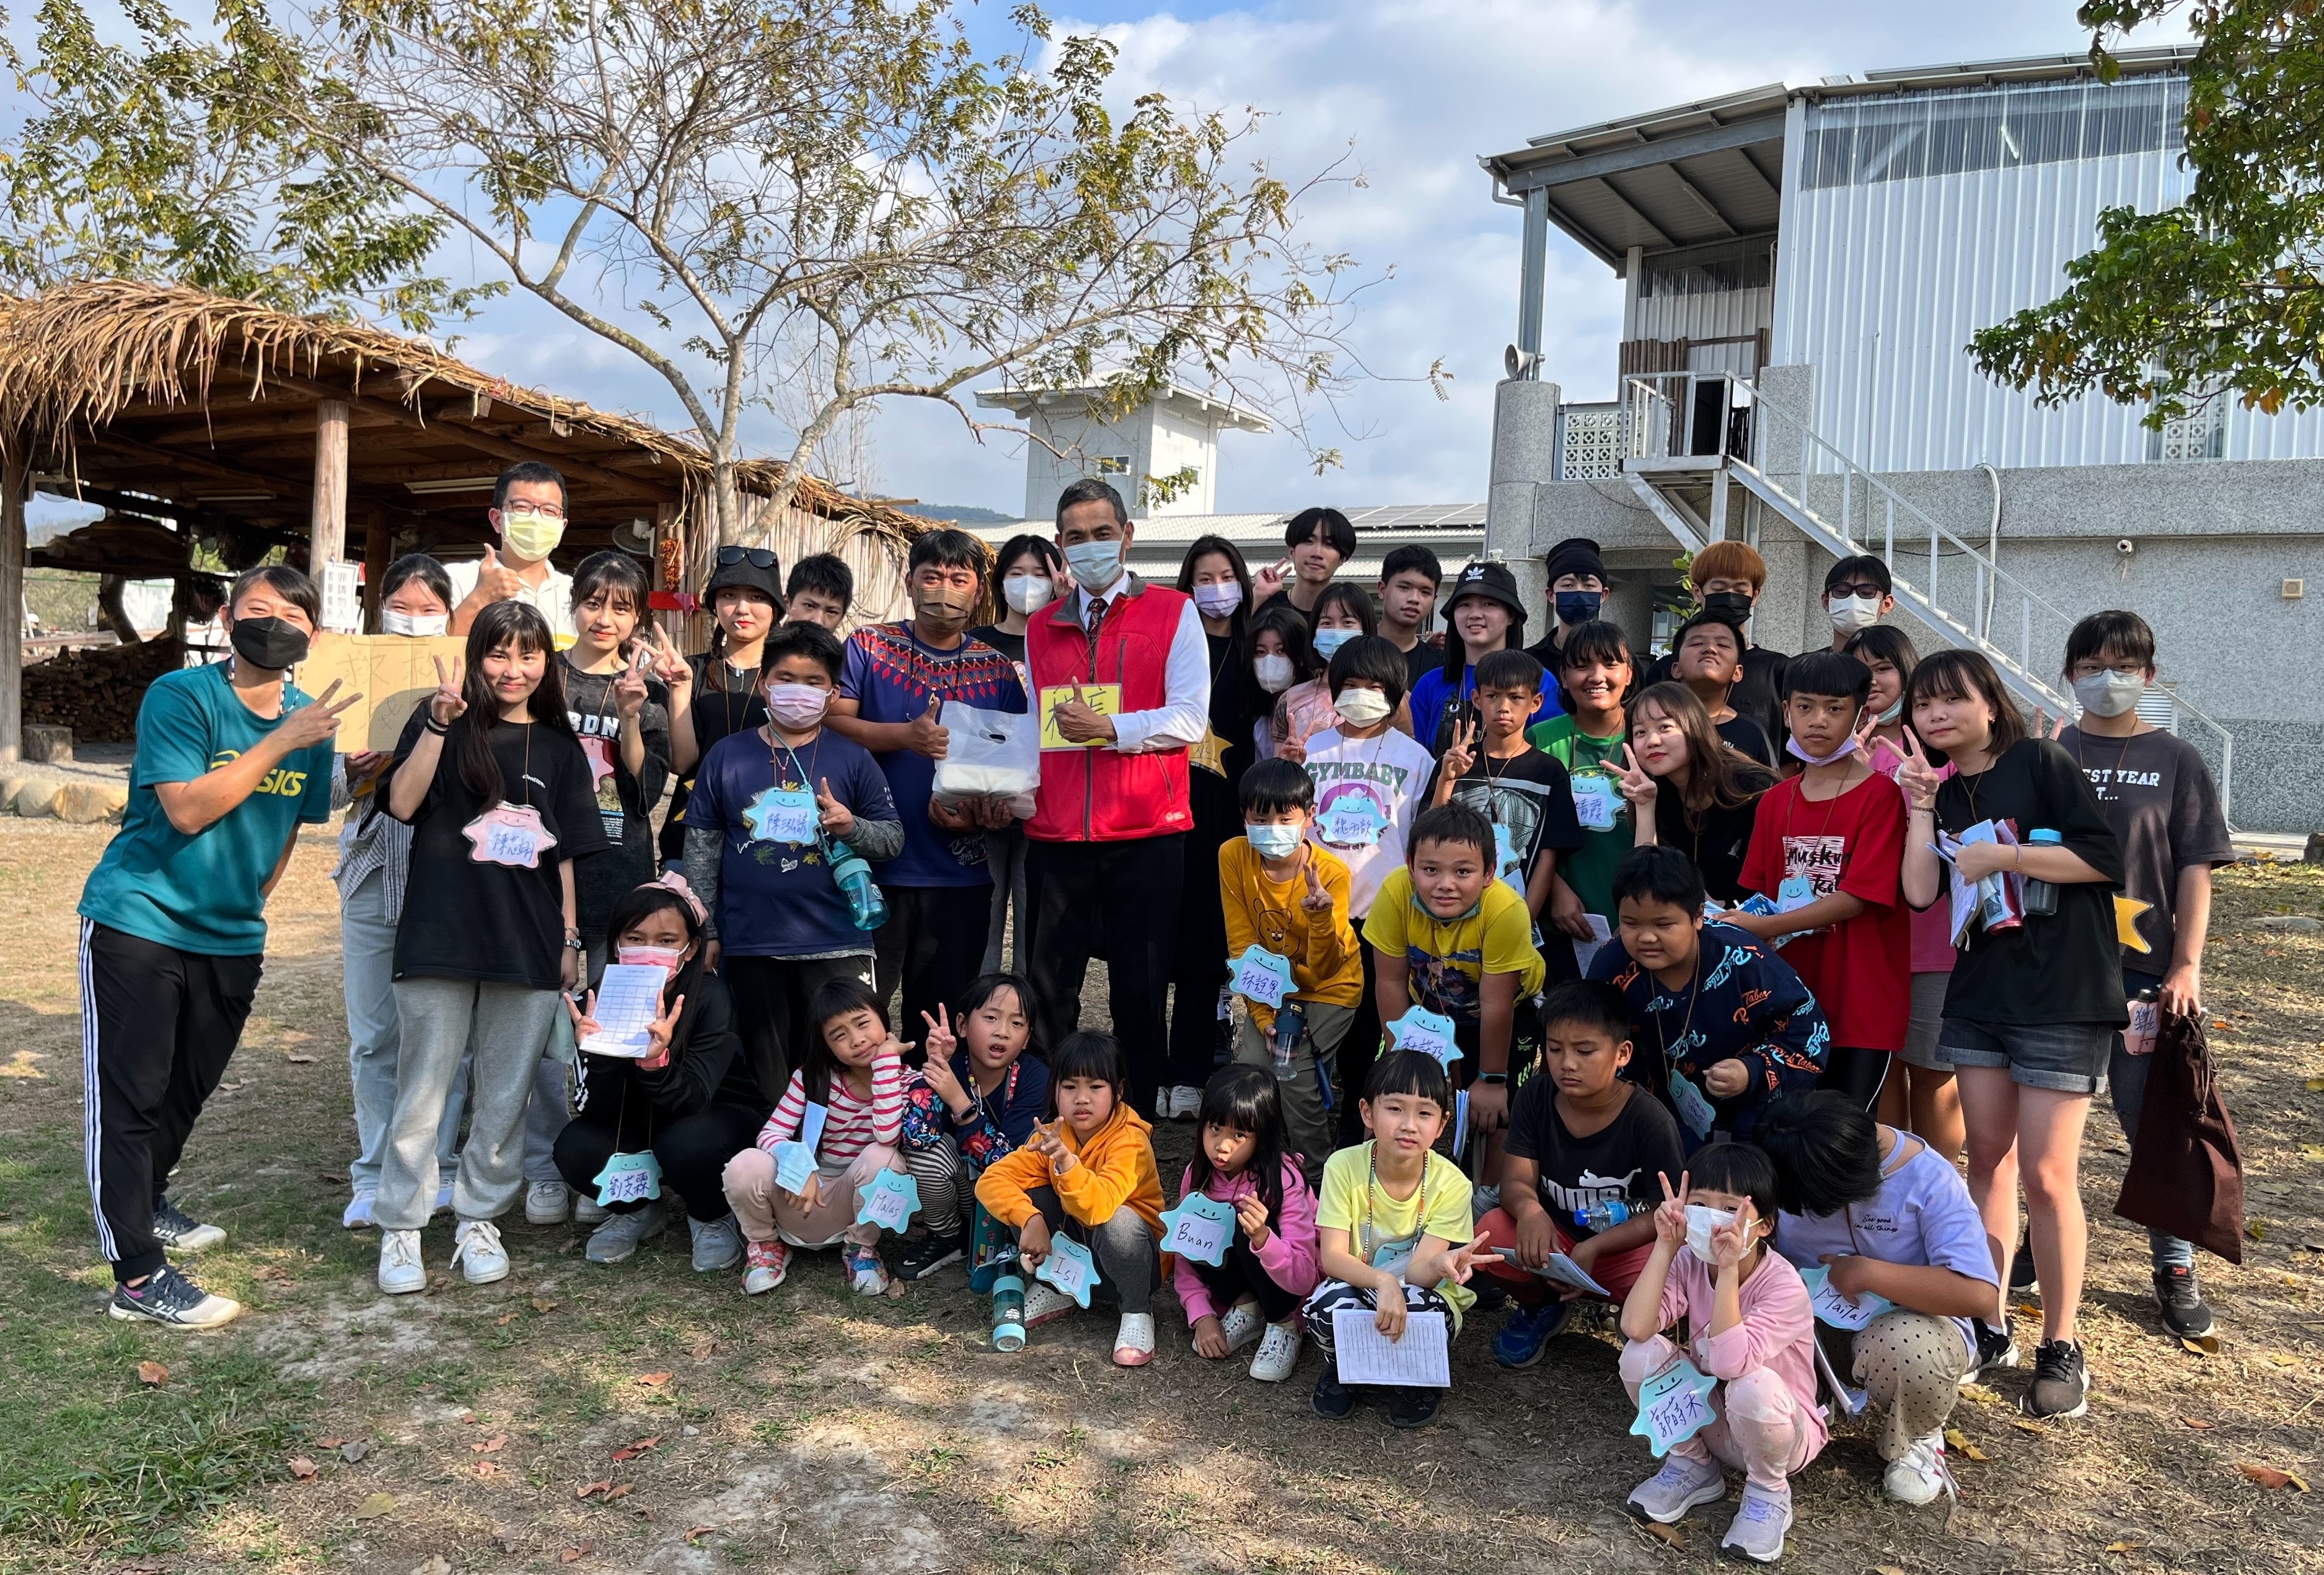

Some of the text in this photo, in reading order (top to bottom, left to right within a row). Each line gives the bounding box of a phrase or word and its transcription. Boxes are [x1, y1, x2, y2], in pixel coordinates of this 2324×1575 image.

[337, 573, 347, 619] 非請勿入
[255, 768, 307, 797] SICS
[1305, 761, 1408, 797] GYMBABY
[2116, 770, 2160, 787] YEAR
[1862, 1214, 1892, 1225] See good
[1876, 1225, 1899, 1233] things
[1177, 1222, 1213, 1250] Buan
[1054, 1256, 1076, 1285] Isi
